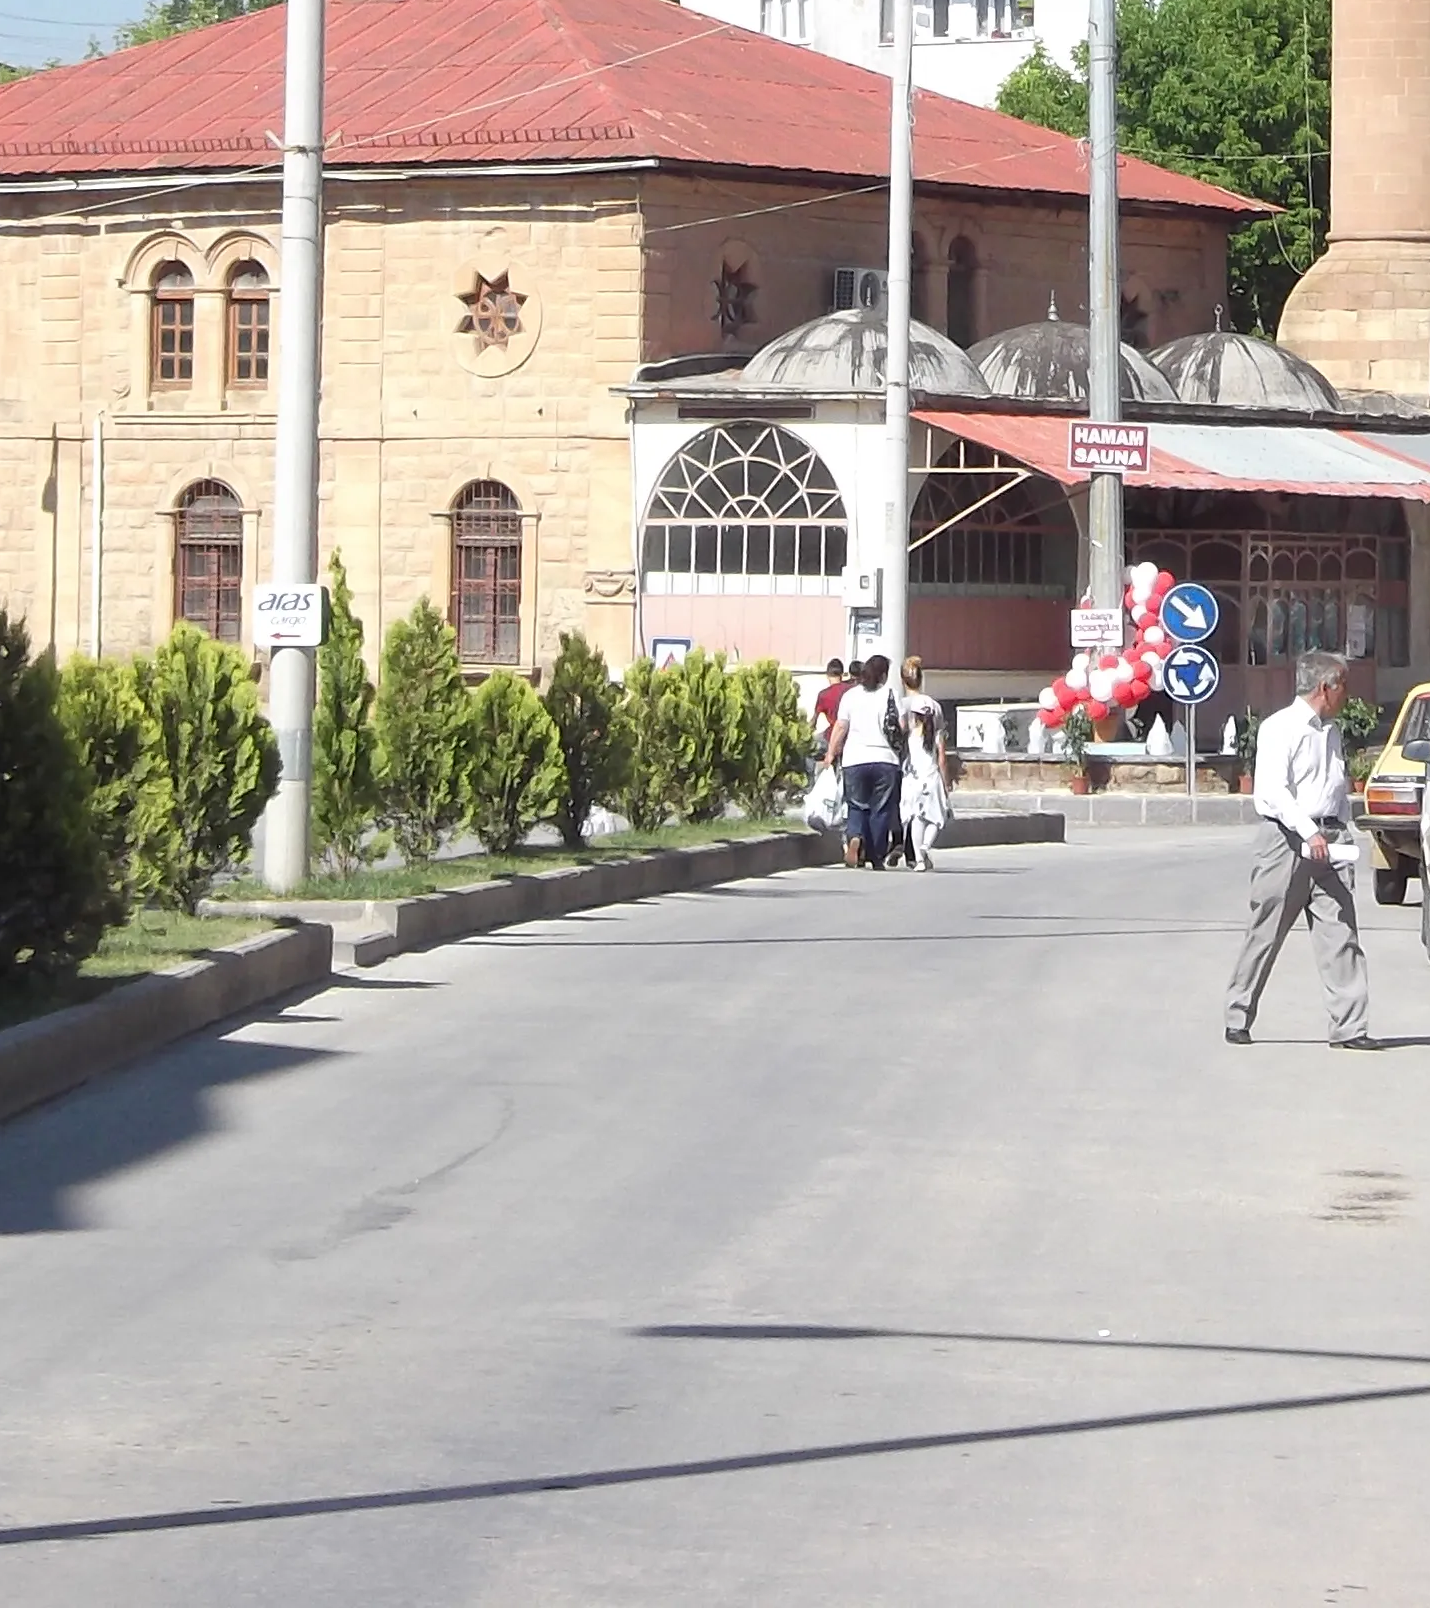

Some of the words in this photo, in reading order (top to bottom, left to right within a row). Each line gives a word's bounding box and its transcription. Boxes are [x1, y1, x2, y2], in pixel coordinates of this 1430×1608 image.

[1074, 426, 1144, 447] HAMAM
[1074, 447, 1142, 466] SAUNA
[258, 593, 314, 611] aras
